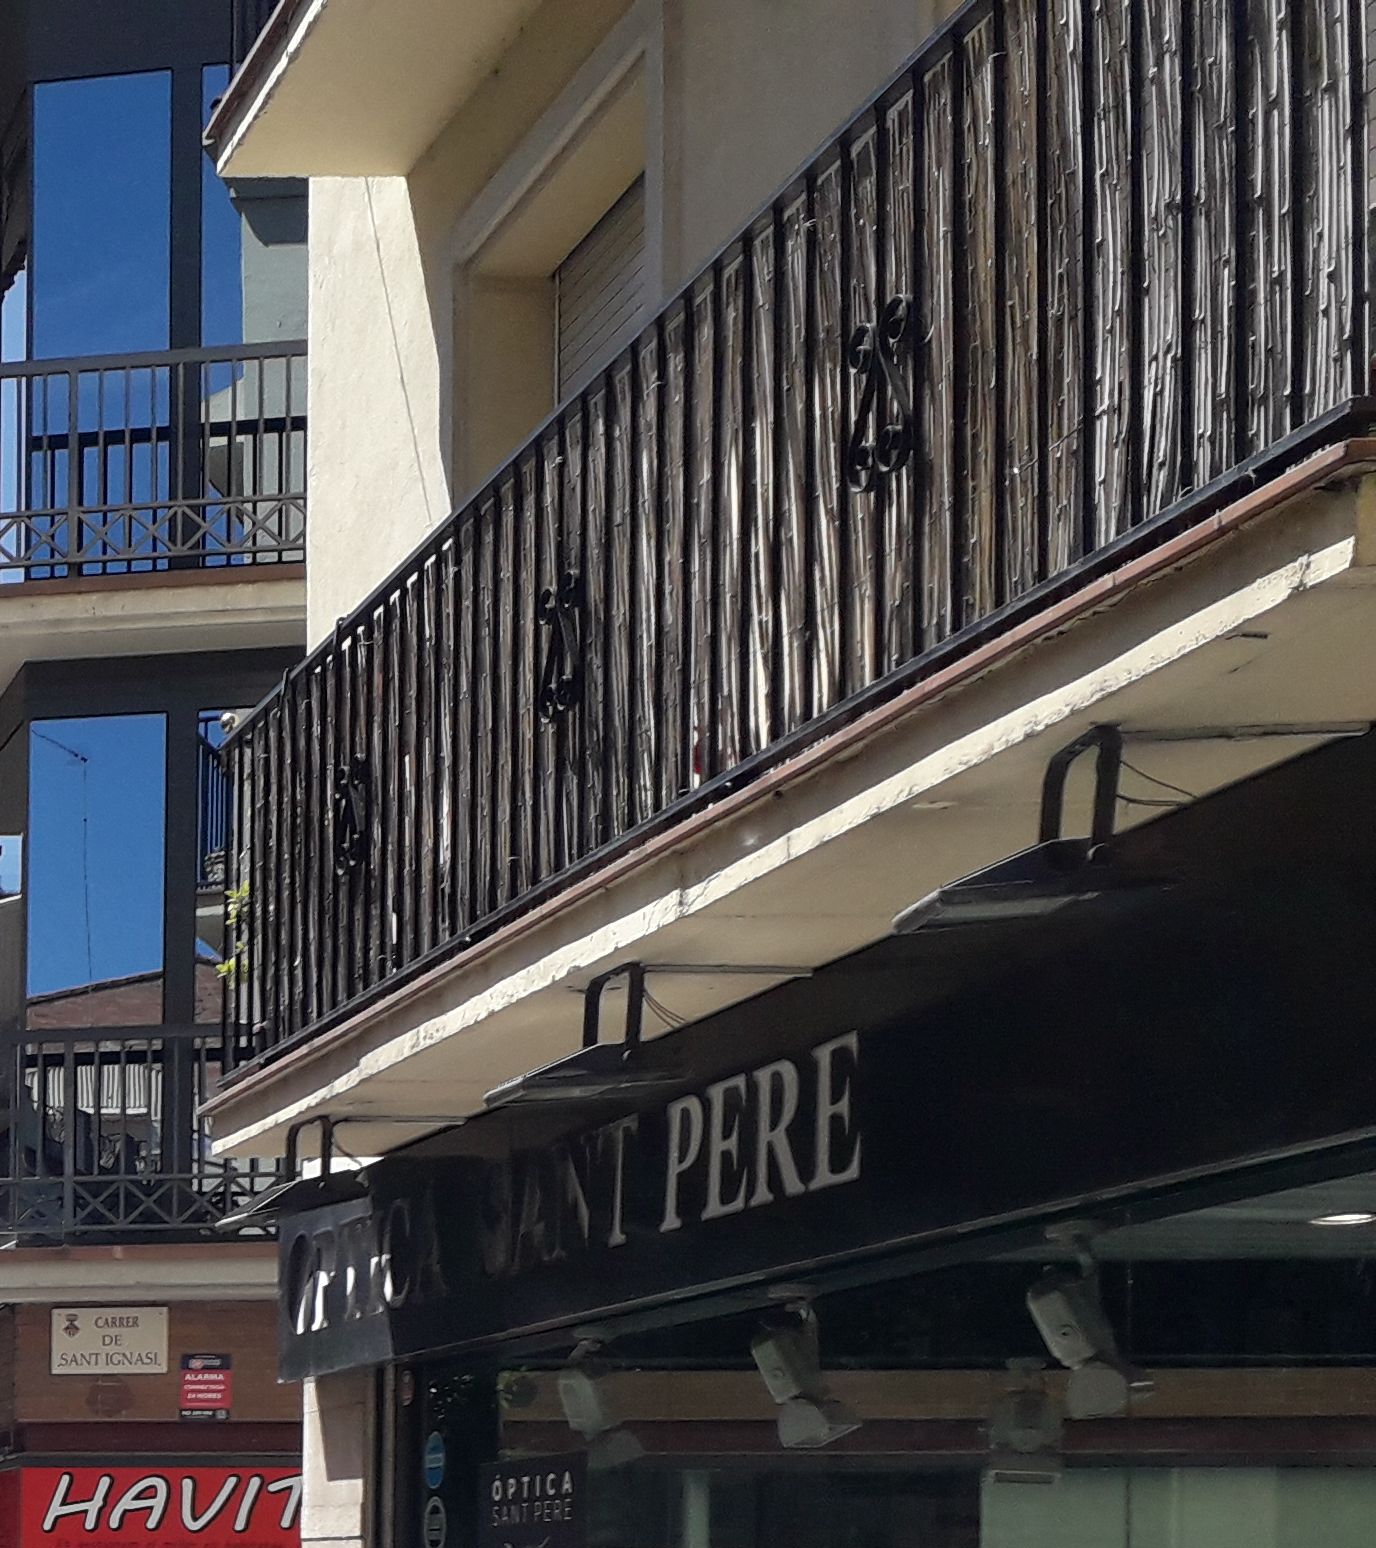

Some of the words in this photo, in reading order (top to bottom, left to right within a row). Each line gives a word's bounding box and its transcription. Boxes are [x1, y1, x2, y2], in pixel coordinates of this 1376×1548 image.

[658, 1028, 861, 1232] PERE
[94, 1315, 140, 1329] CARRER
[101, 1334, 122, 1347] DE
[57, 1352, 101, 1368] SANT
[105, 1351, 162, 1367] IGNASI
[184, 1373, 225, 1381] ALARMA
[492, 1470, 574, 1502] ÓPTICA
[491, 1502, 530, 1527] SANT
[533, 1498, 573, 1523] PERE
